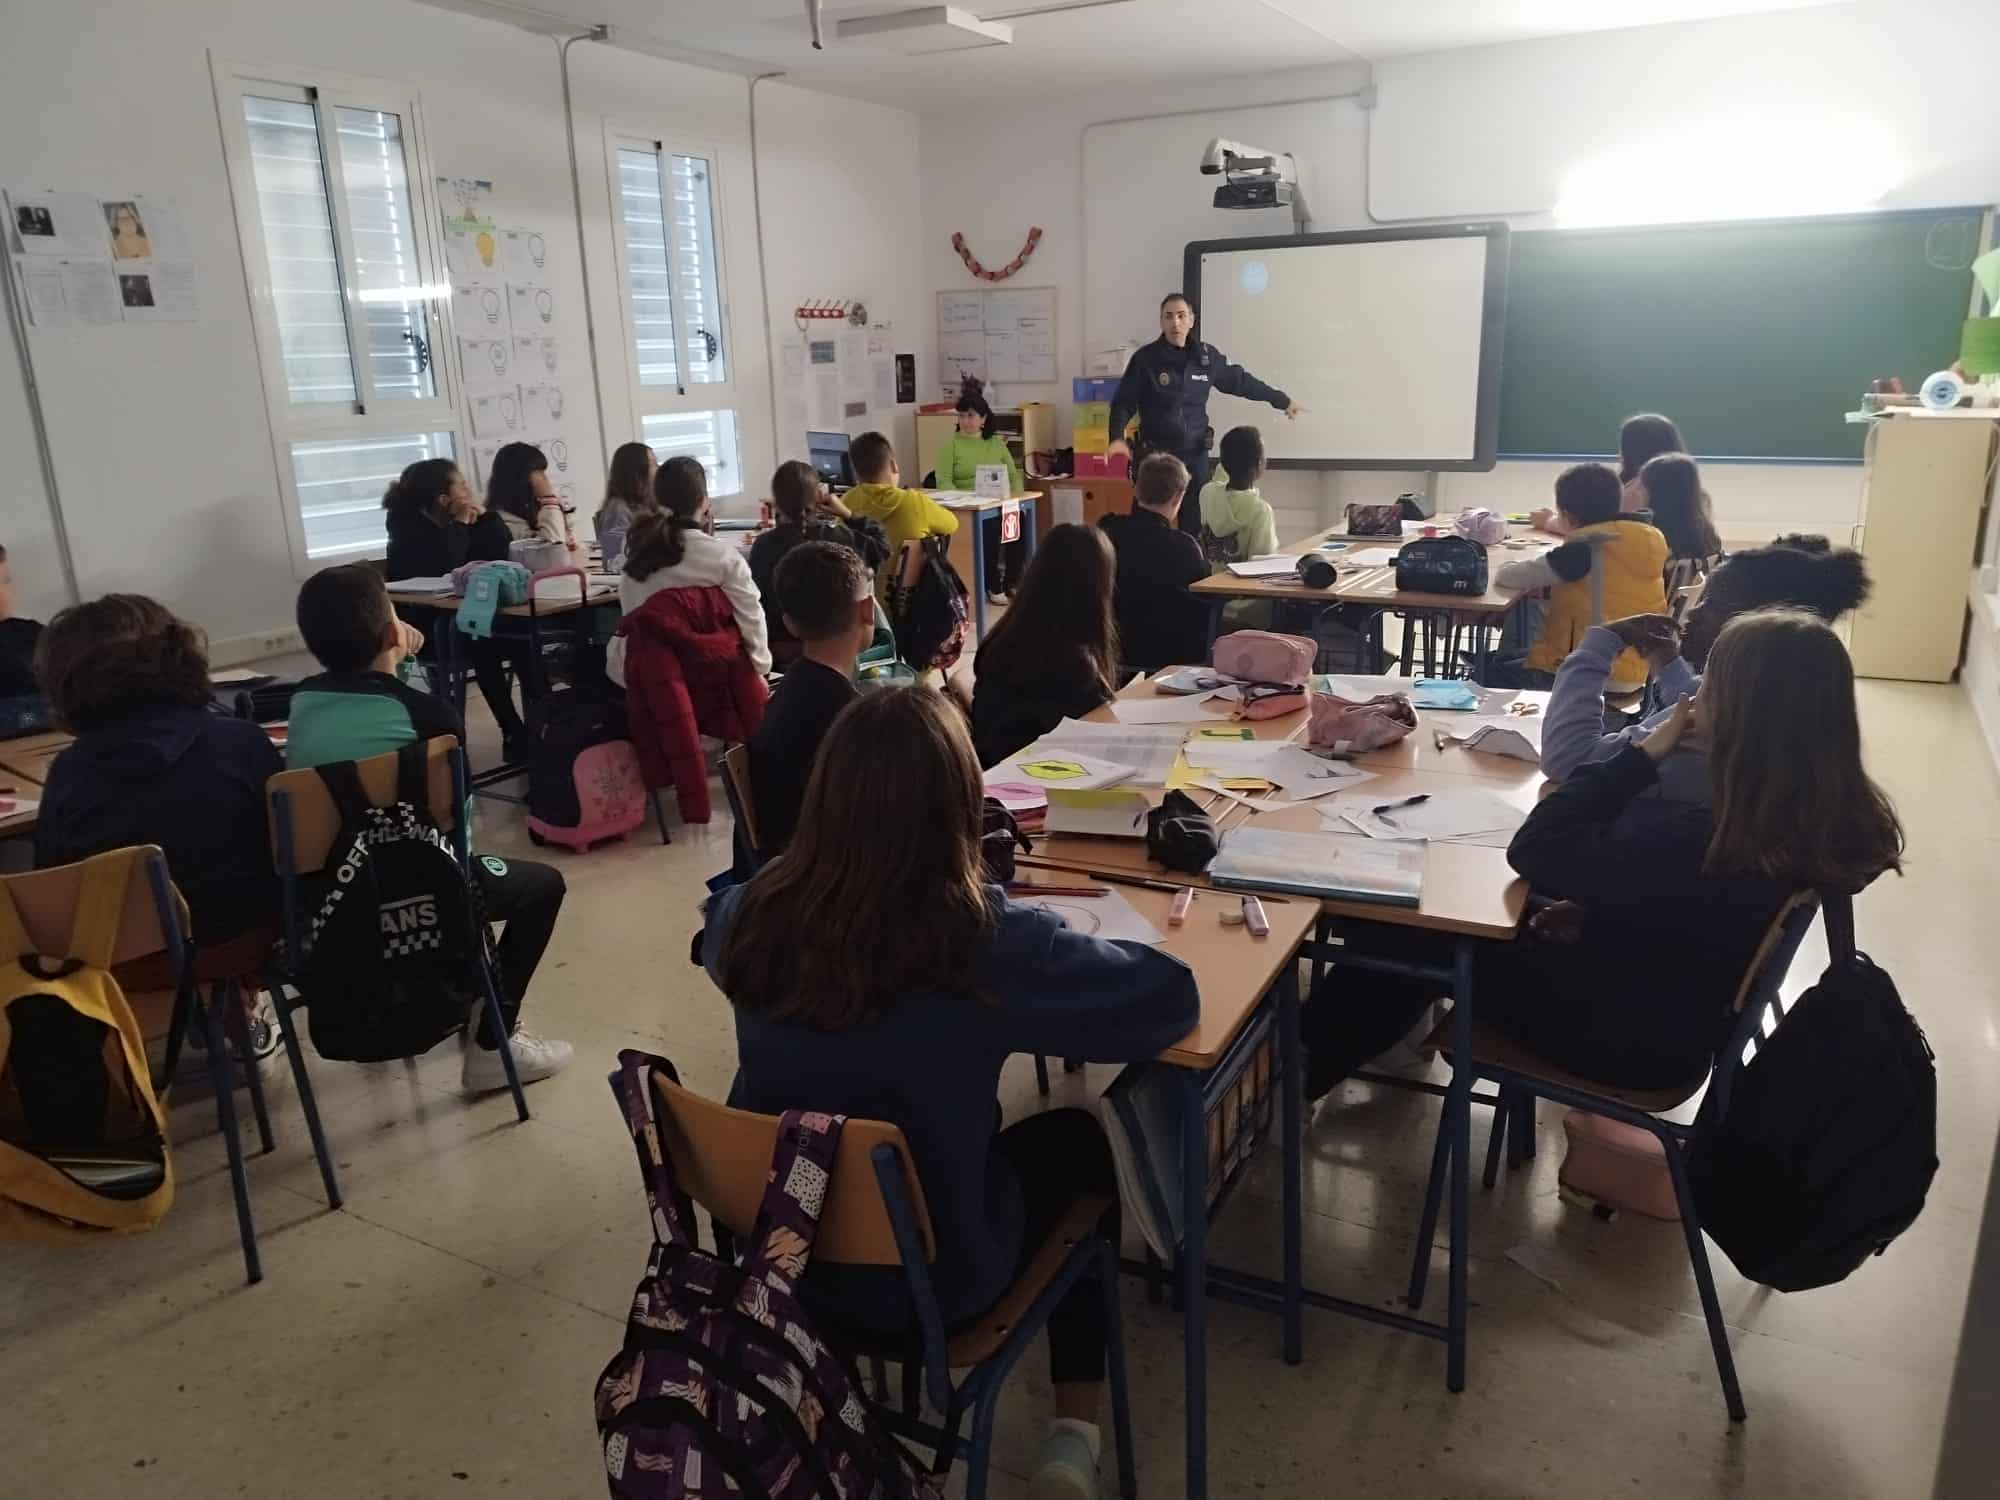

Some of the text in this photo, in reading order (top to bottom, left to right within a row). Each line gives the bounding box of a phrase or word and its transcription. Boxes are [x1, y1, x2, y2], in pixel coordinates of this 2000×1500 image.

[337, 831, 369, 884] OFF
[408, 823, 458, 864] WALL
[379, 896, 439, 934] ANS
